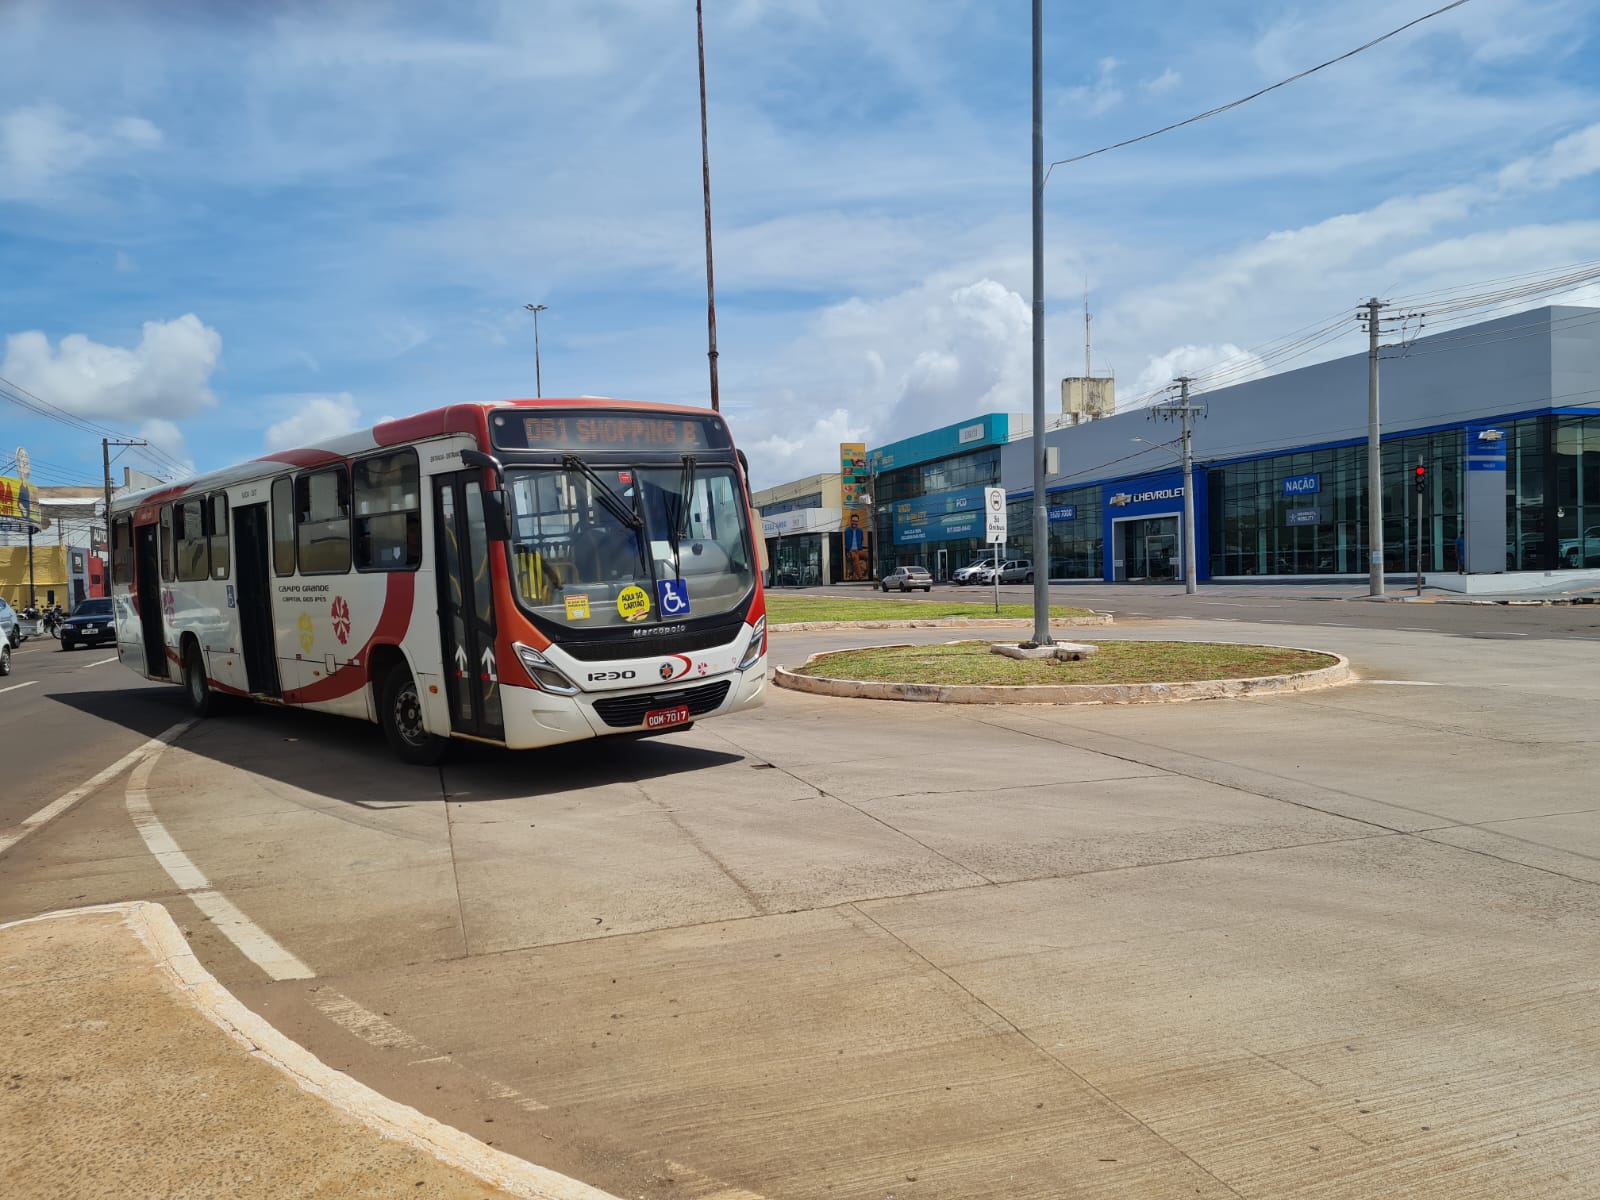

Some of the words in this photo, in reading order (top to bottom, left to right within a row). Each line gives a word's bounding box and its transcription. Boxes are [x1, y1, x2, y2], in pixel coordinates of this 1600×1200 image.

[576, 419, 677, 443] SHOPPING
[1286, 477, 1315, 492] NAÇÃO
[1133, 487, 1184, 503] CHEVROLET
[278, 585, 301, 593] CAMPO
[621, 593, 635, 602] AQUI
[633, 625, 686, 636] Marcopolo
[588, 670, 636, 681] 1230
